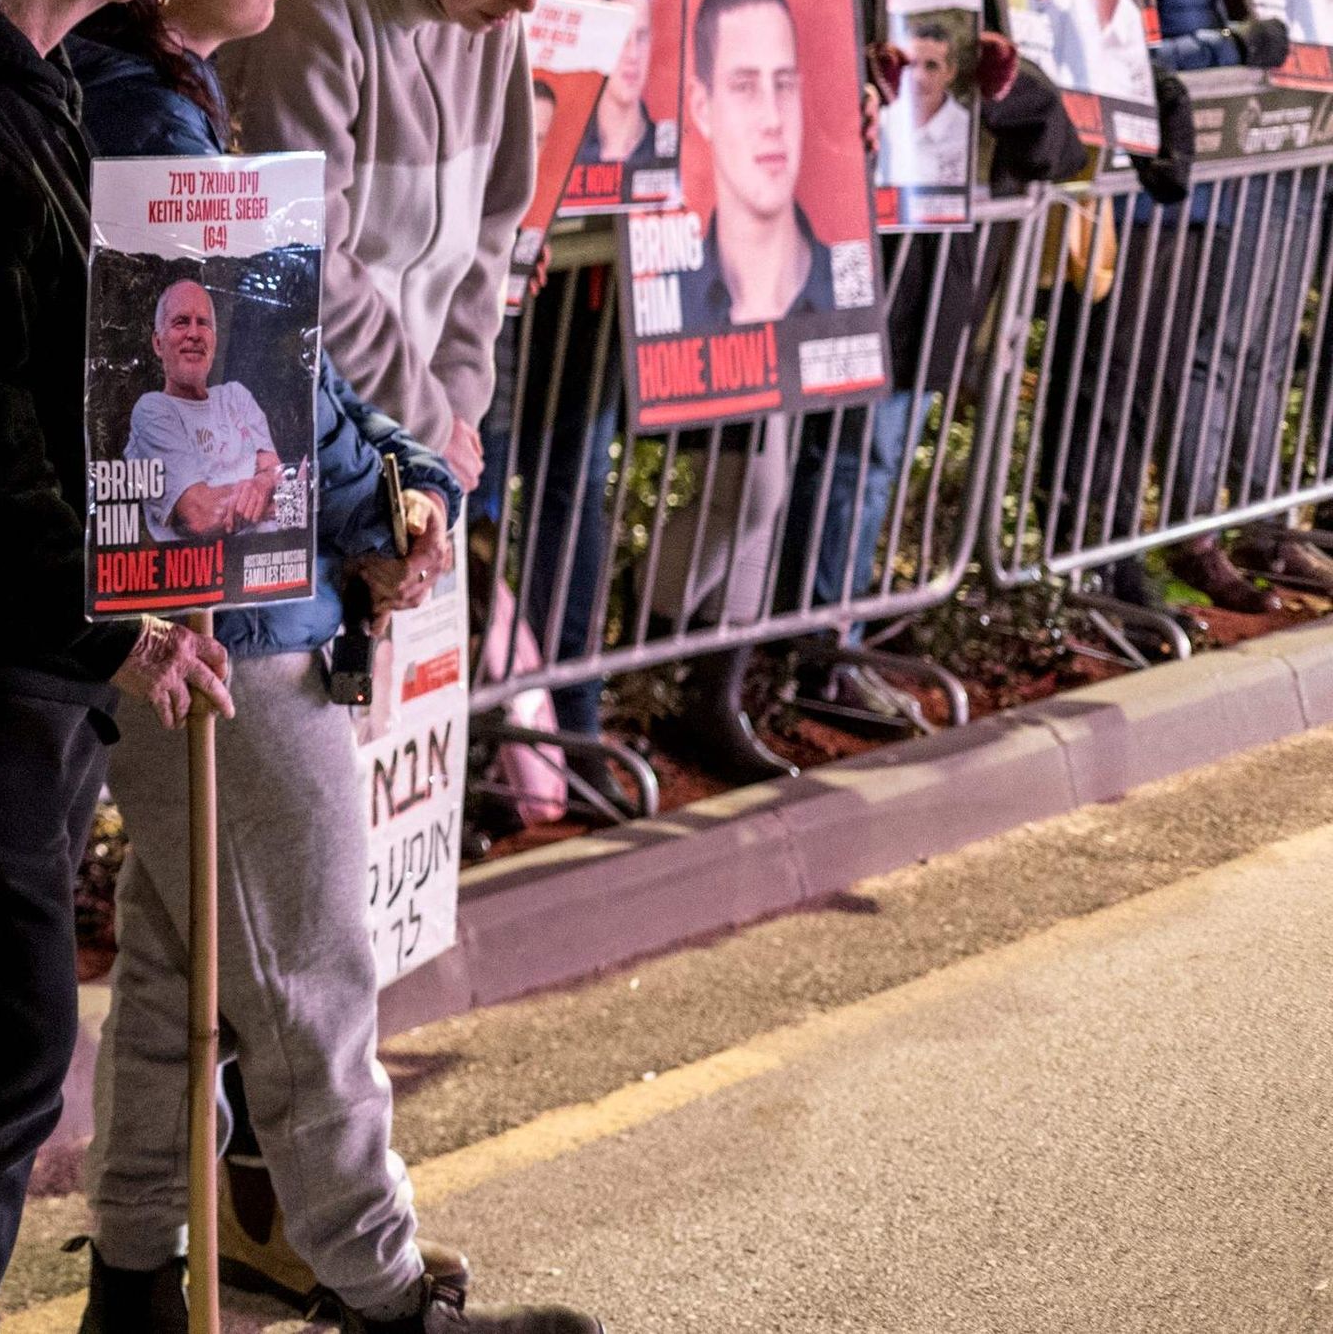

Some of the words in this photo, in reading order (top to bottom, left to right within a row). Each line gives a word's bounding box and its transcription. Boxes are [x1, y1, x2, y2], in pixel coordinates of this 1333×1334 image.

[169, 171, 197, 195] סיגל
[200, 170, 237, 195] סמואל
[239, 170, 260, 195] קית
[148, 200, 184, 224] KEITH
[186, 198, 233, 222] SAMUEL
[203, 225, 228, 251] (64)
[629, 211, 704, 274] BRING
[633, 273, 683, 337] HIM
[637, 337, 707, 401] HOME
[709, 321, 779, 392] NOW!
[96, 458, 165, 501] BRING
[97, 502, 140, 546] HIM
[97, 548, 160, 594] HOME
[165, 539, 224, 589] NOW!
[244, 565, 279, 587] FAMILIES
[279, 562, 308, 583] FORUM
[370, 720, 452, 828] אבא
